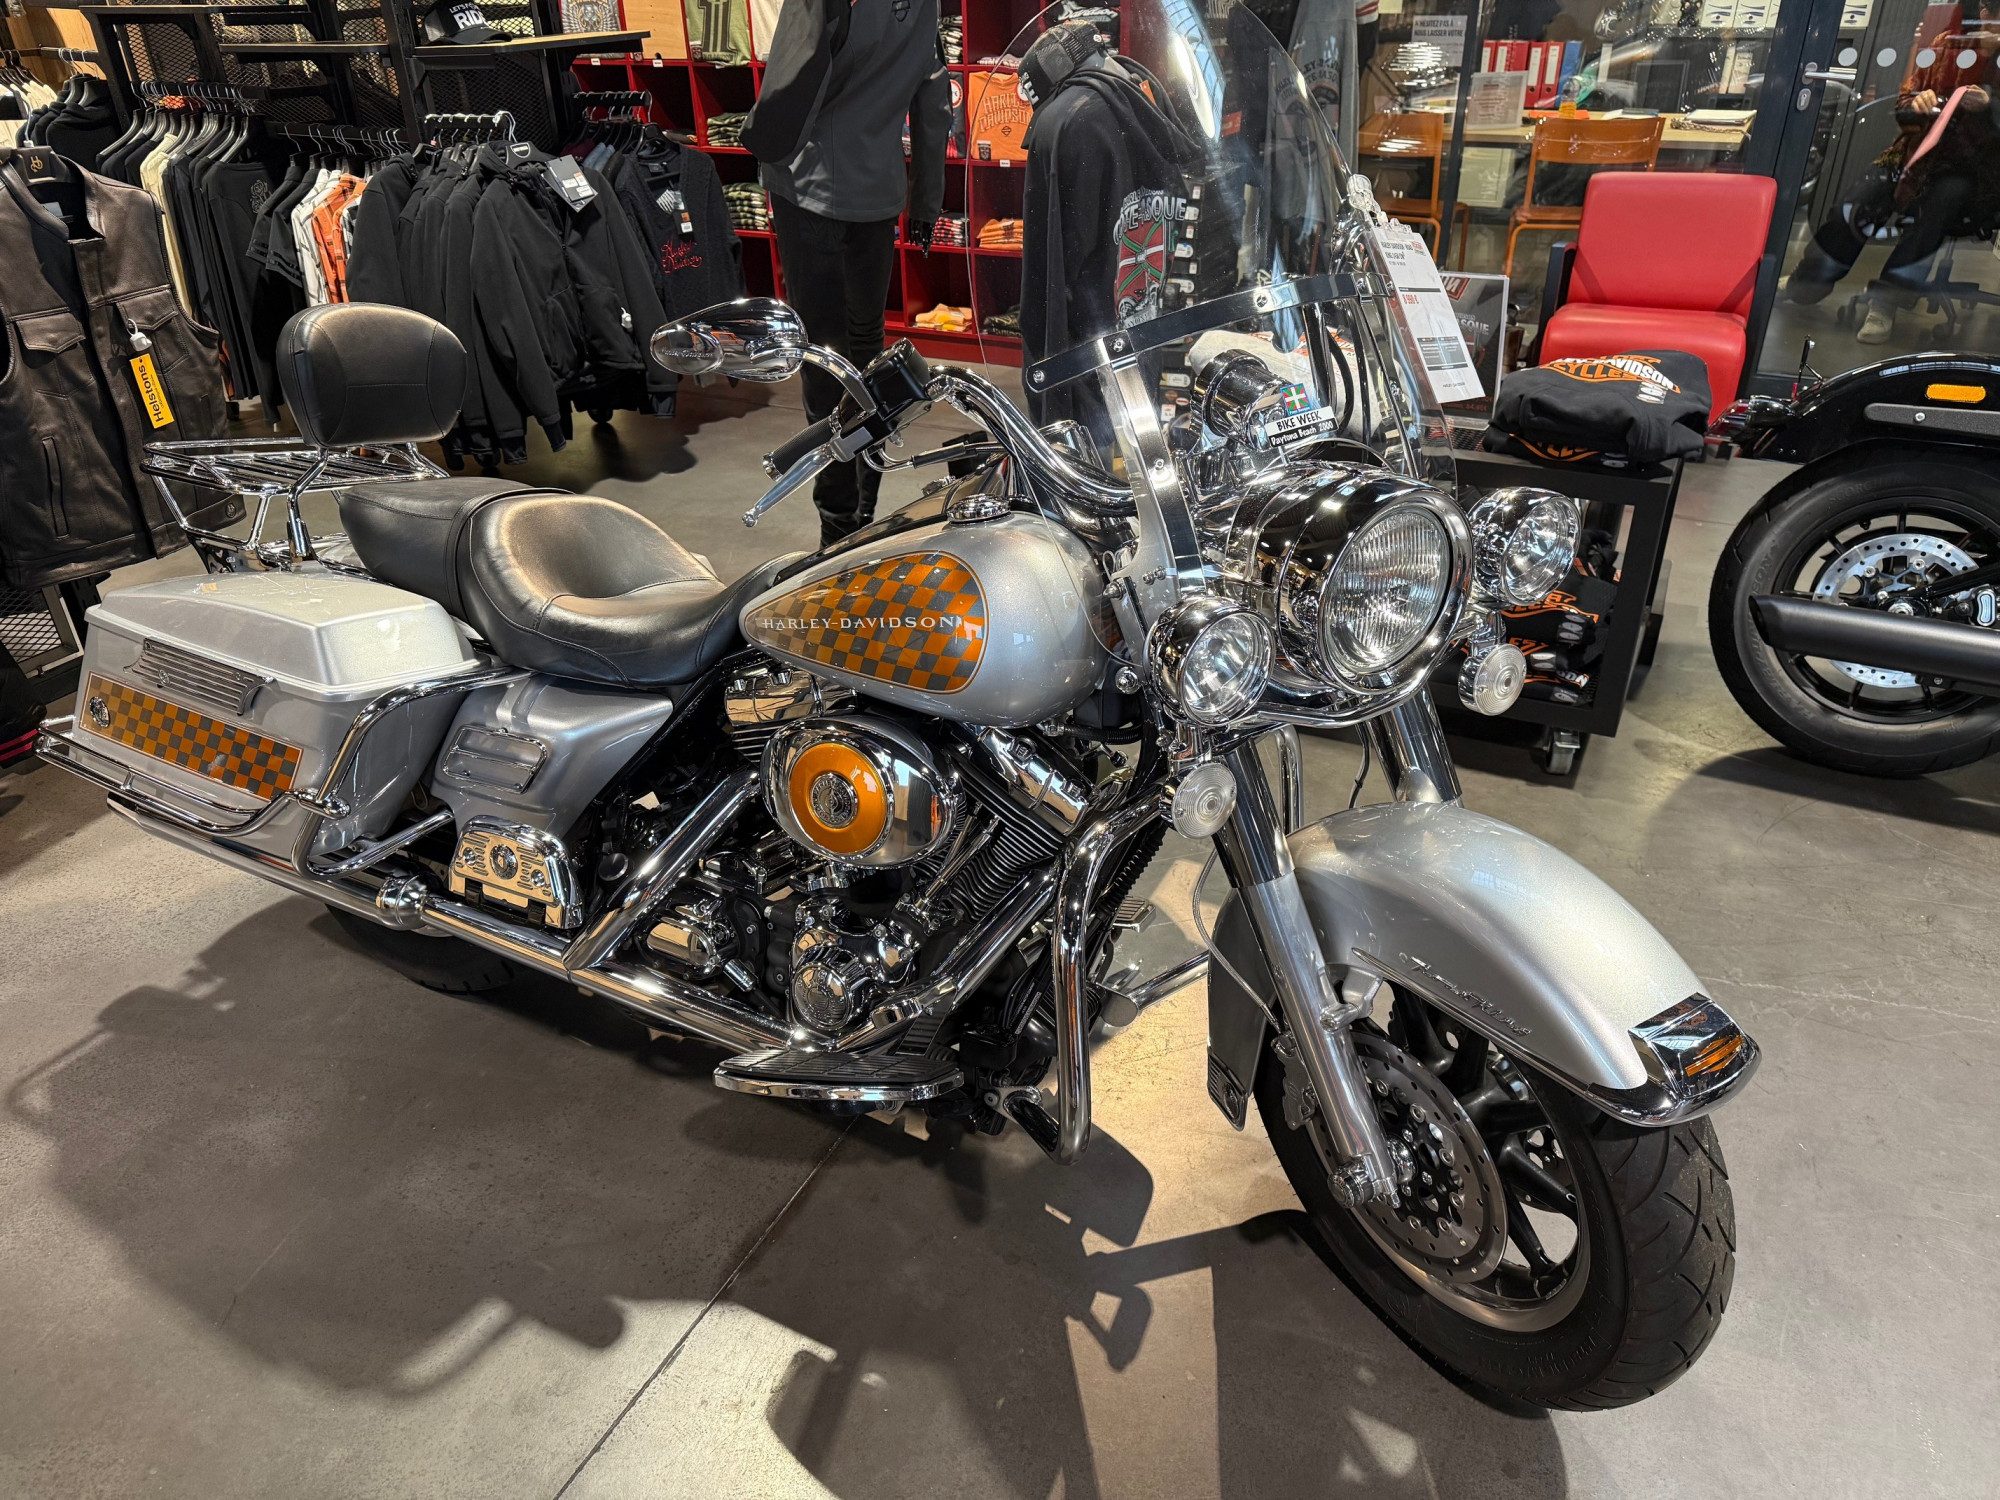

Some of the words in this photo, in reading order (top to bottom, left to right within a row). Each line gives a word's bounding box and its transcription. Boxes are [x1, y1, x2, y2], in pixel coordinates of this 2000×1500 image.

[984, 92, 1020, 114] HARLE
[1458, 318, 1490, 332] SQUE
[139, 365, 164, 422] Helstons
[1276, 417, 1296, 431] BIKE
[1297, 411, 1322, 425] WEEK
[1270, 432, 1298, 445] Daytona
[1298, 425, 1317, 438] Beach
[1318, 421, 1334, 432] 2000
[761, 615, 955, 631] HARLEY-DAVIDSON
